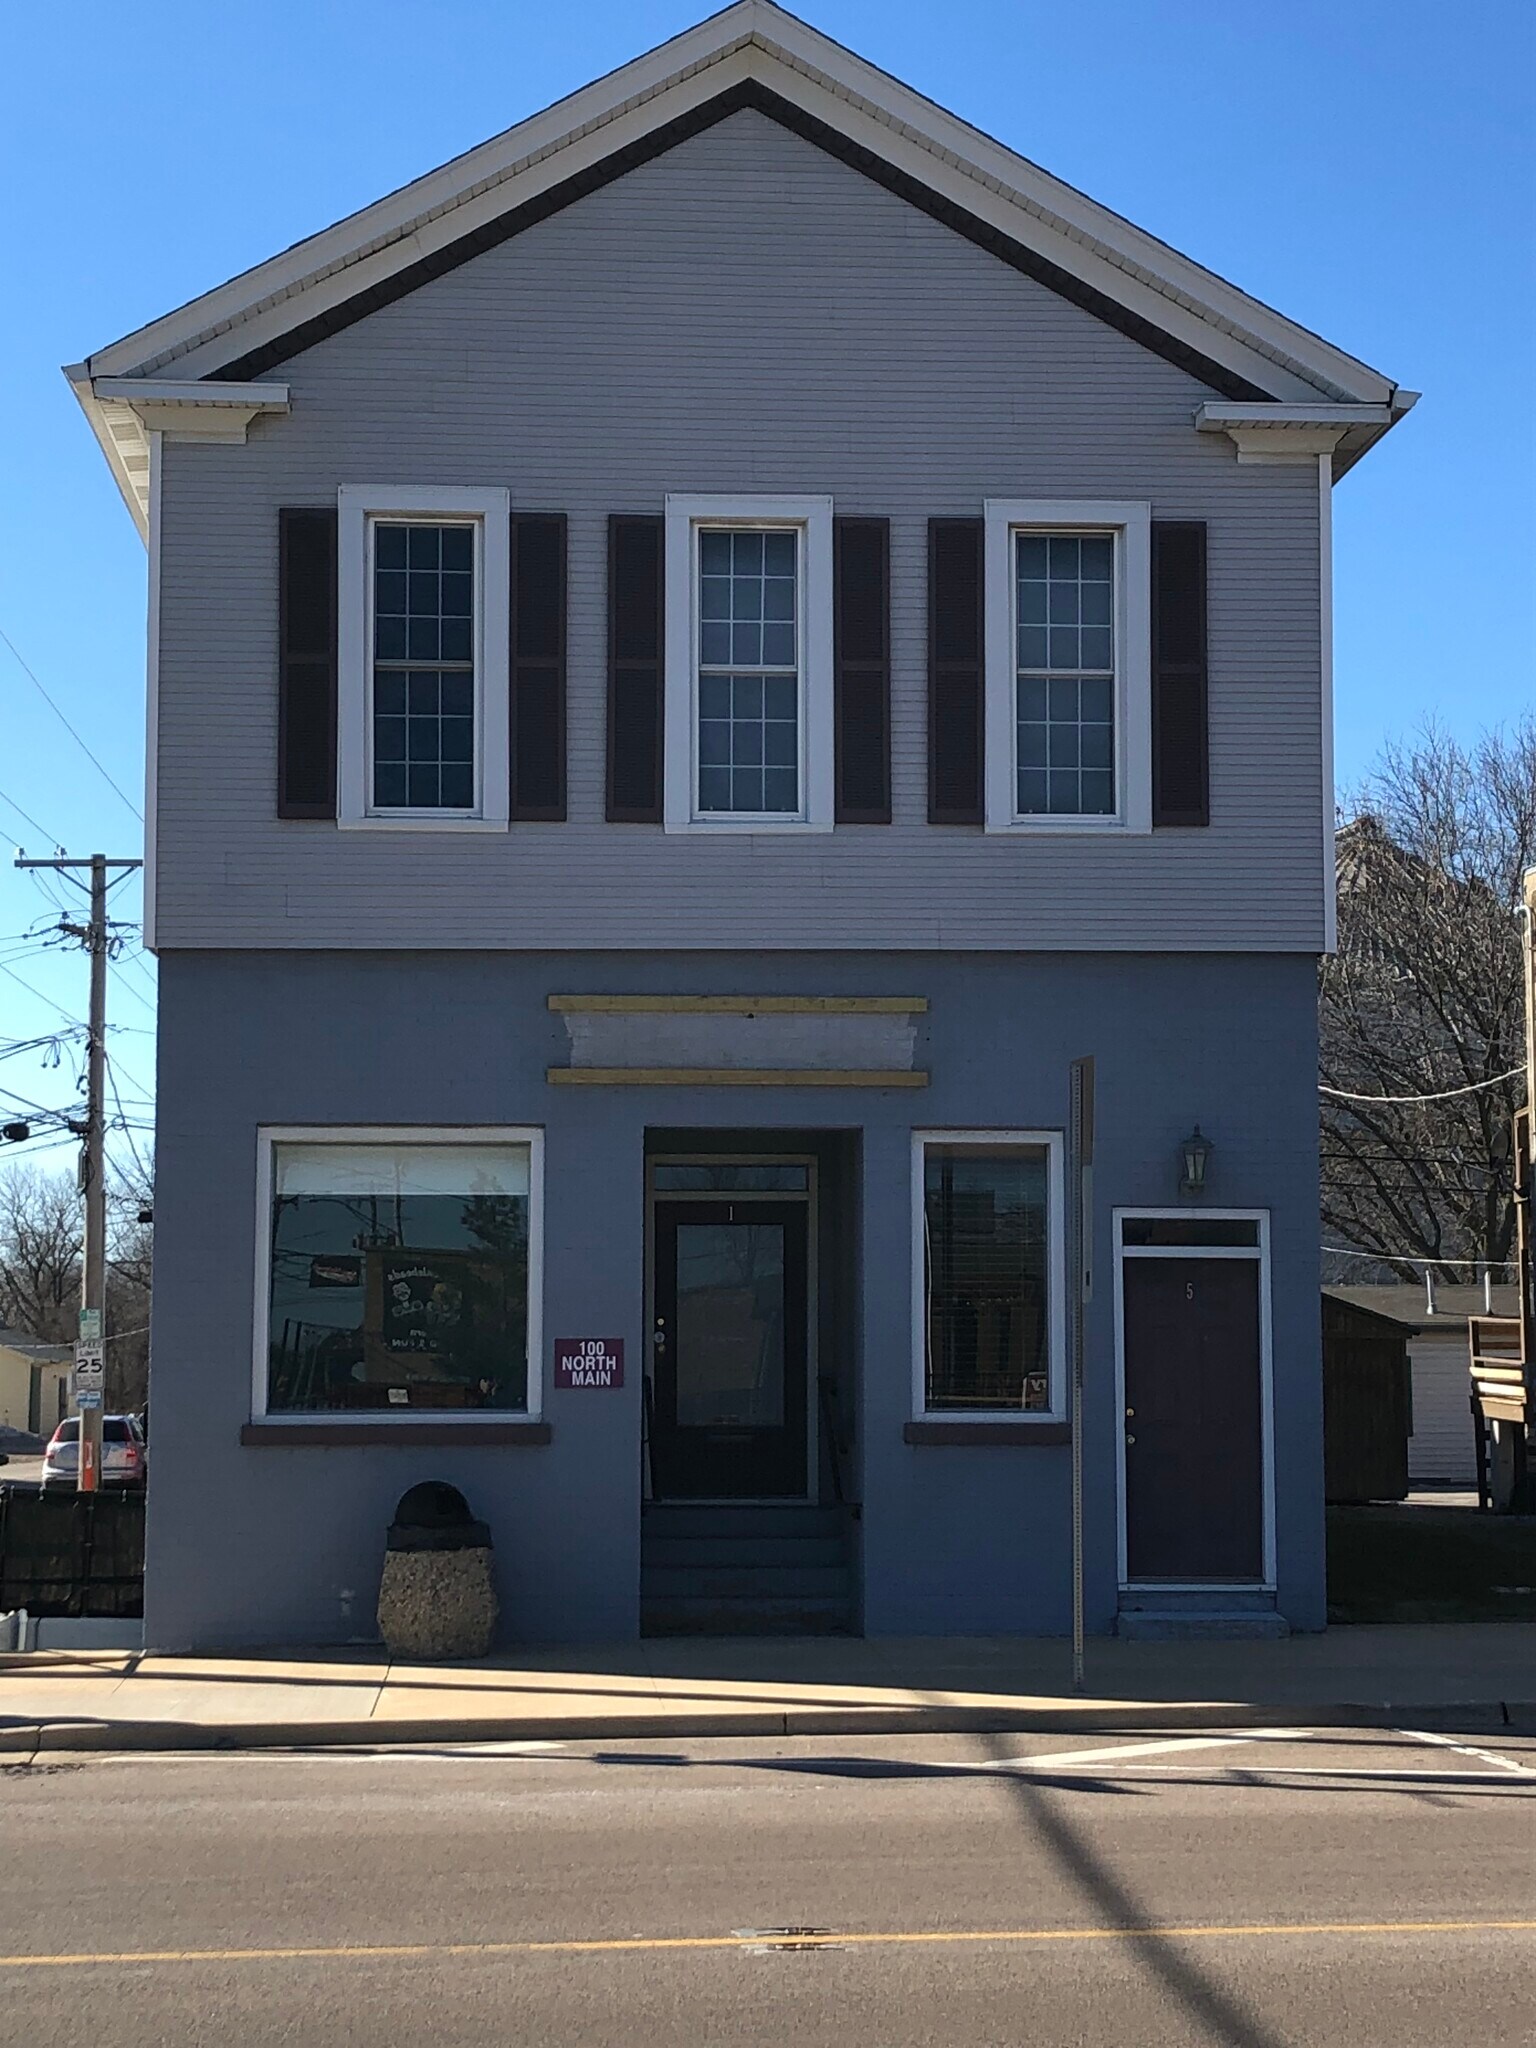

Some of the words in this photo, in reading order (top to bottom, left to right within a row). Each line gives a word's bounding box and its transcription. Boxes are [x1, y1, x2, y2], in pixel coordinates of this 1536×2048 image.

[1186, 1282, 1194, 1300] 5
[579, 1341, 605, 1356] 100
[77, 1358, 103, 1374] 25
[562, 1355, 616, 1370] NORTH
[572, 1370, 611, 1386] MAIN
